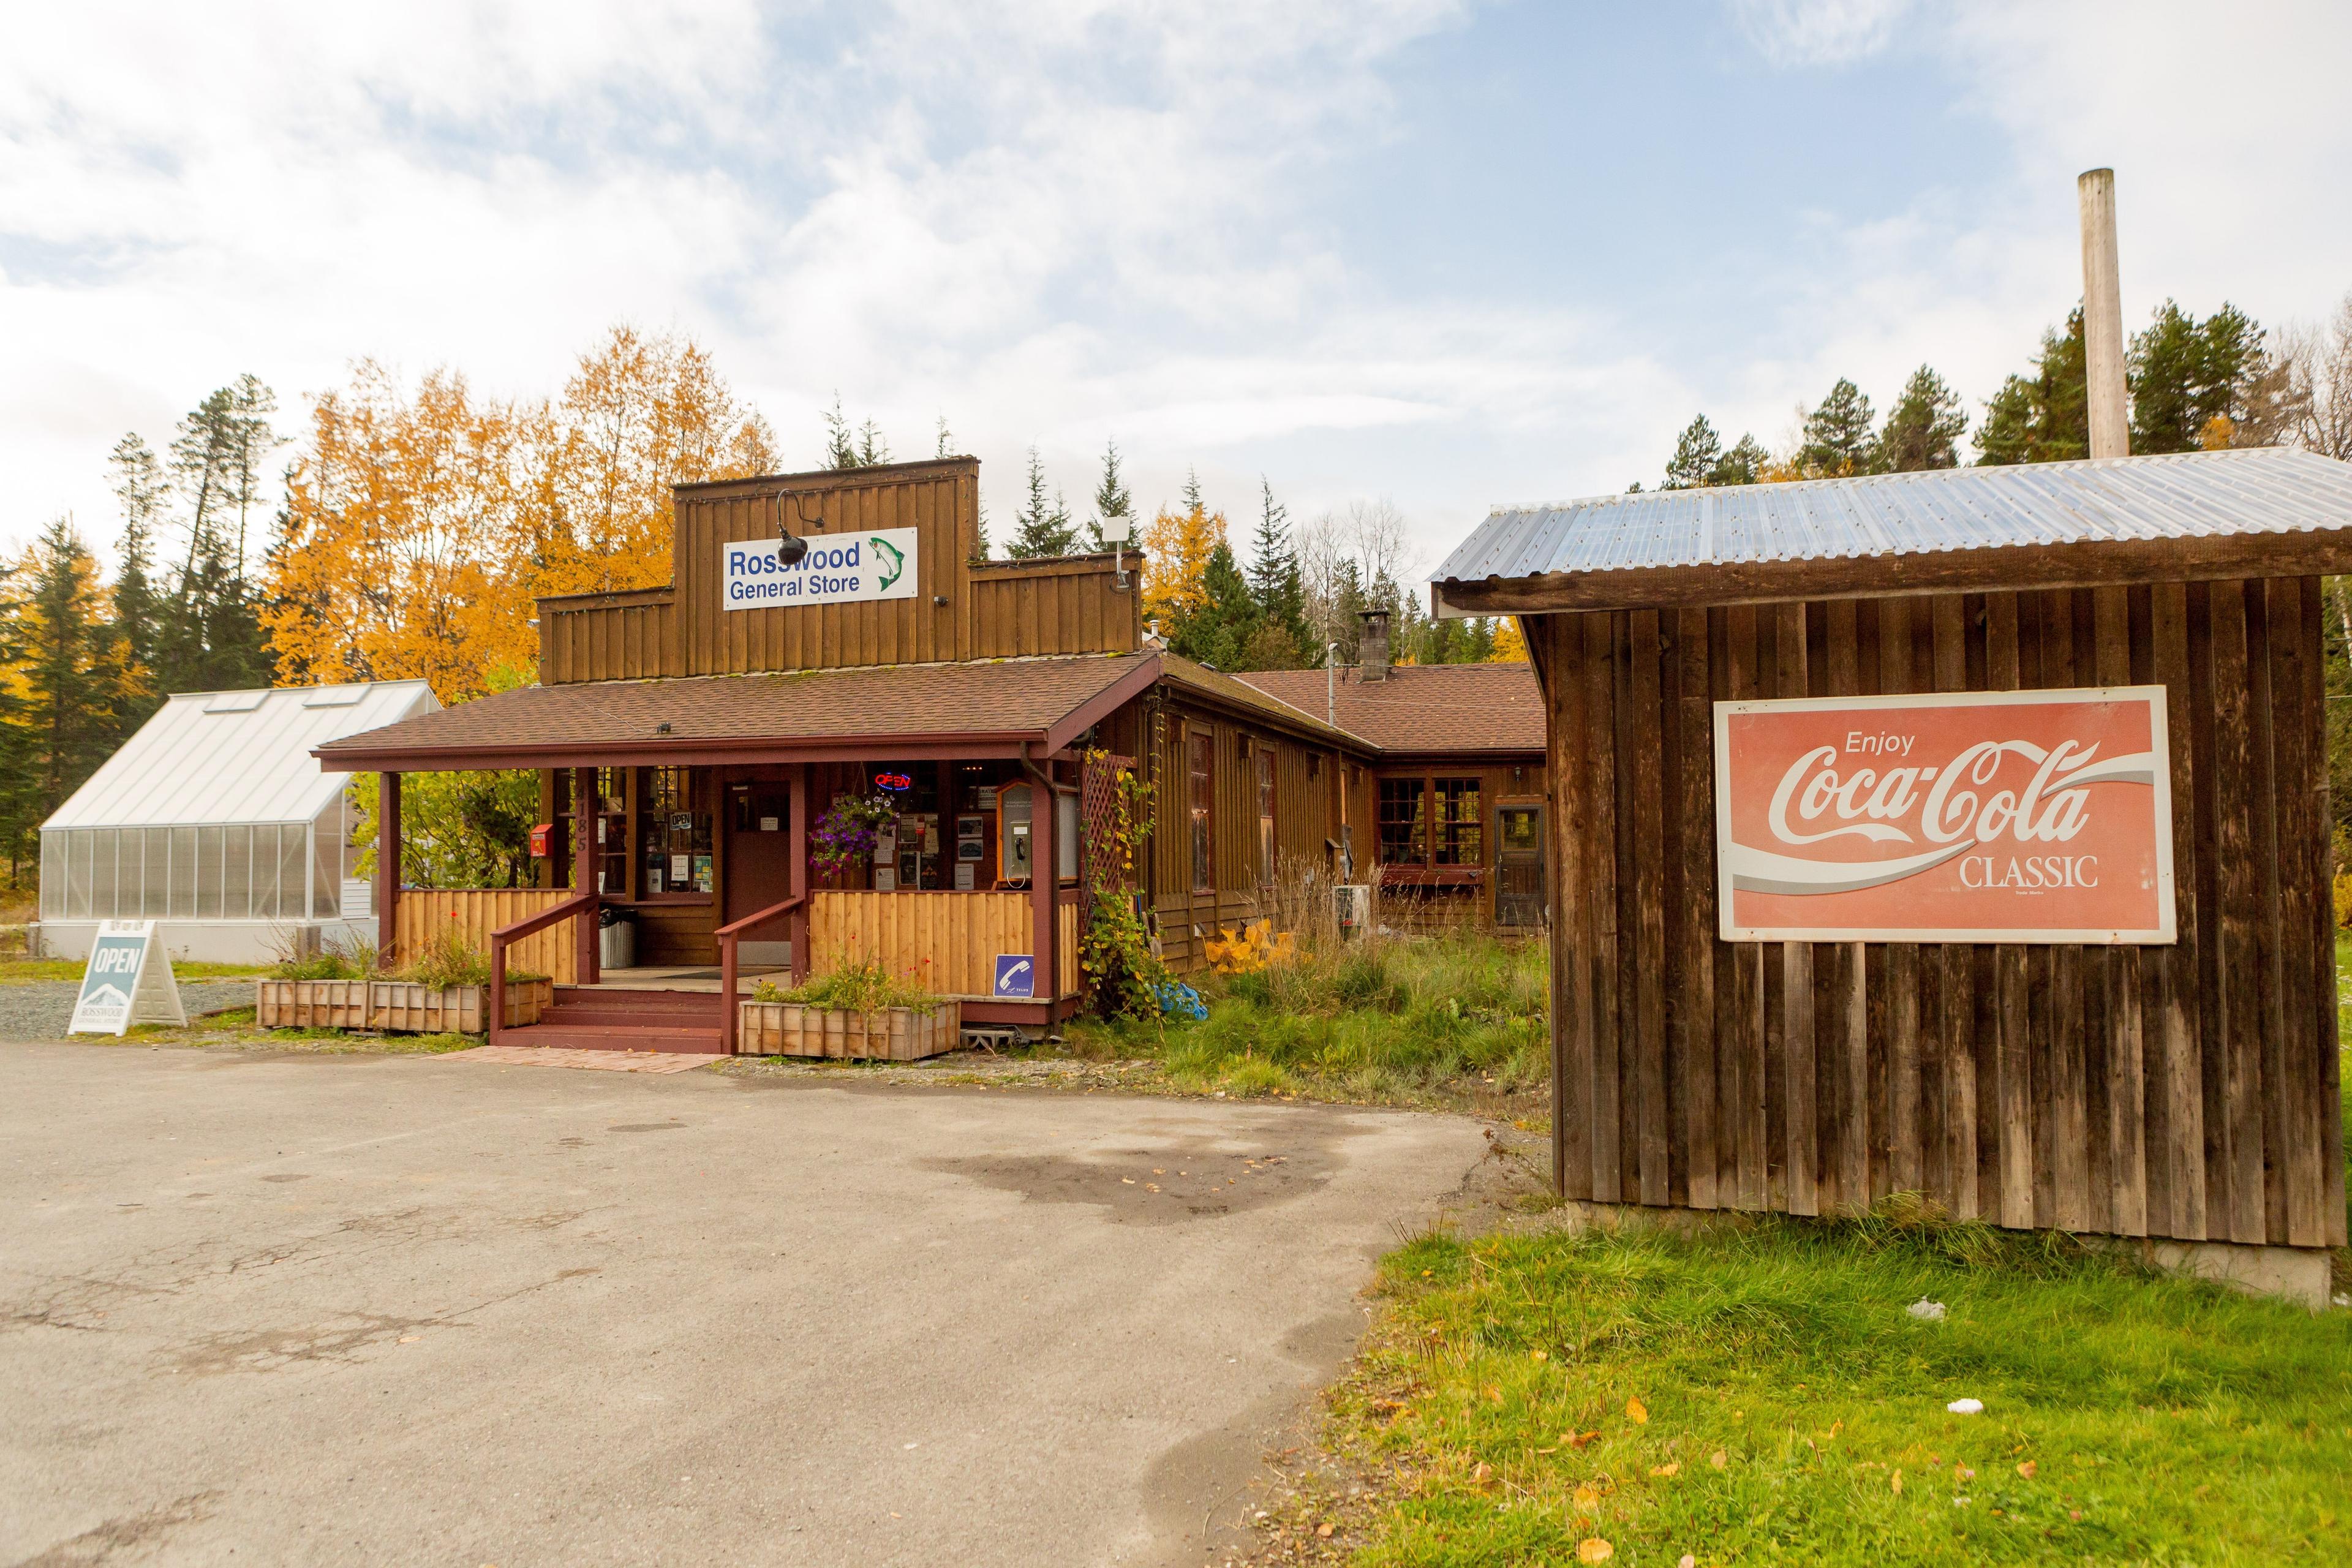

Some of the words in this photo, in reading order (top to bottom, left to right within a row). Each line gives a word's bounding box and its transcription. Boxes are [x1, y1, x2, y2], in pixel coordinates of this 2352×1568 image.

[730, 577, 802, 600] General
[809, 575, 860, 595] Store
[1845, 731, 1916, 756] Enjoy
[875, 774, 911, 787] OPEN
[1768, 739, 2101, 845] Coca-Cola
[577, 785, 587, 852] 4185
[671, 813, 690, 826] OPEN
[1959, 855, 2099, 889] CLASSIC
[94, 948, 140, 973] OPEN
